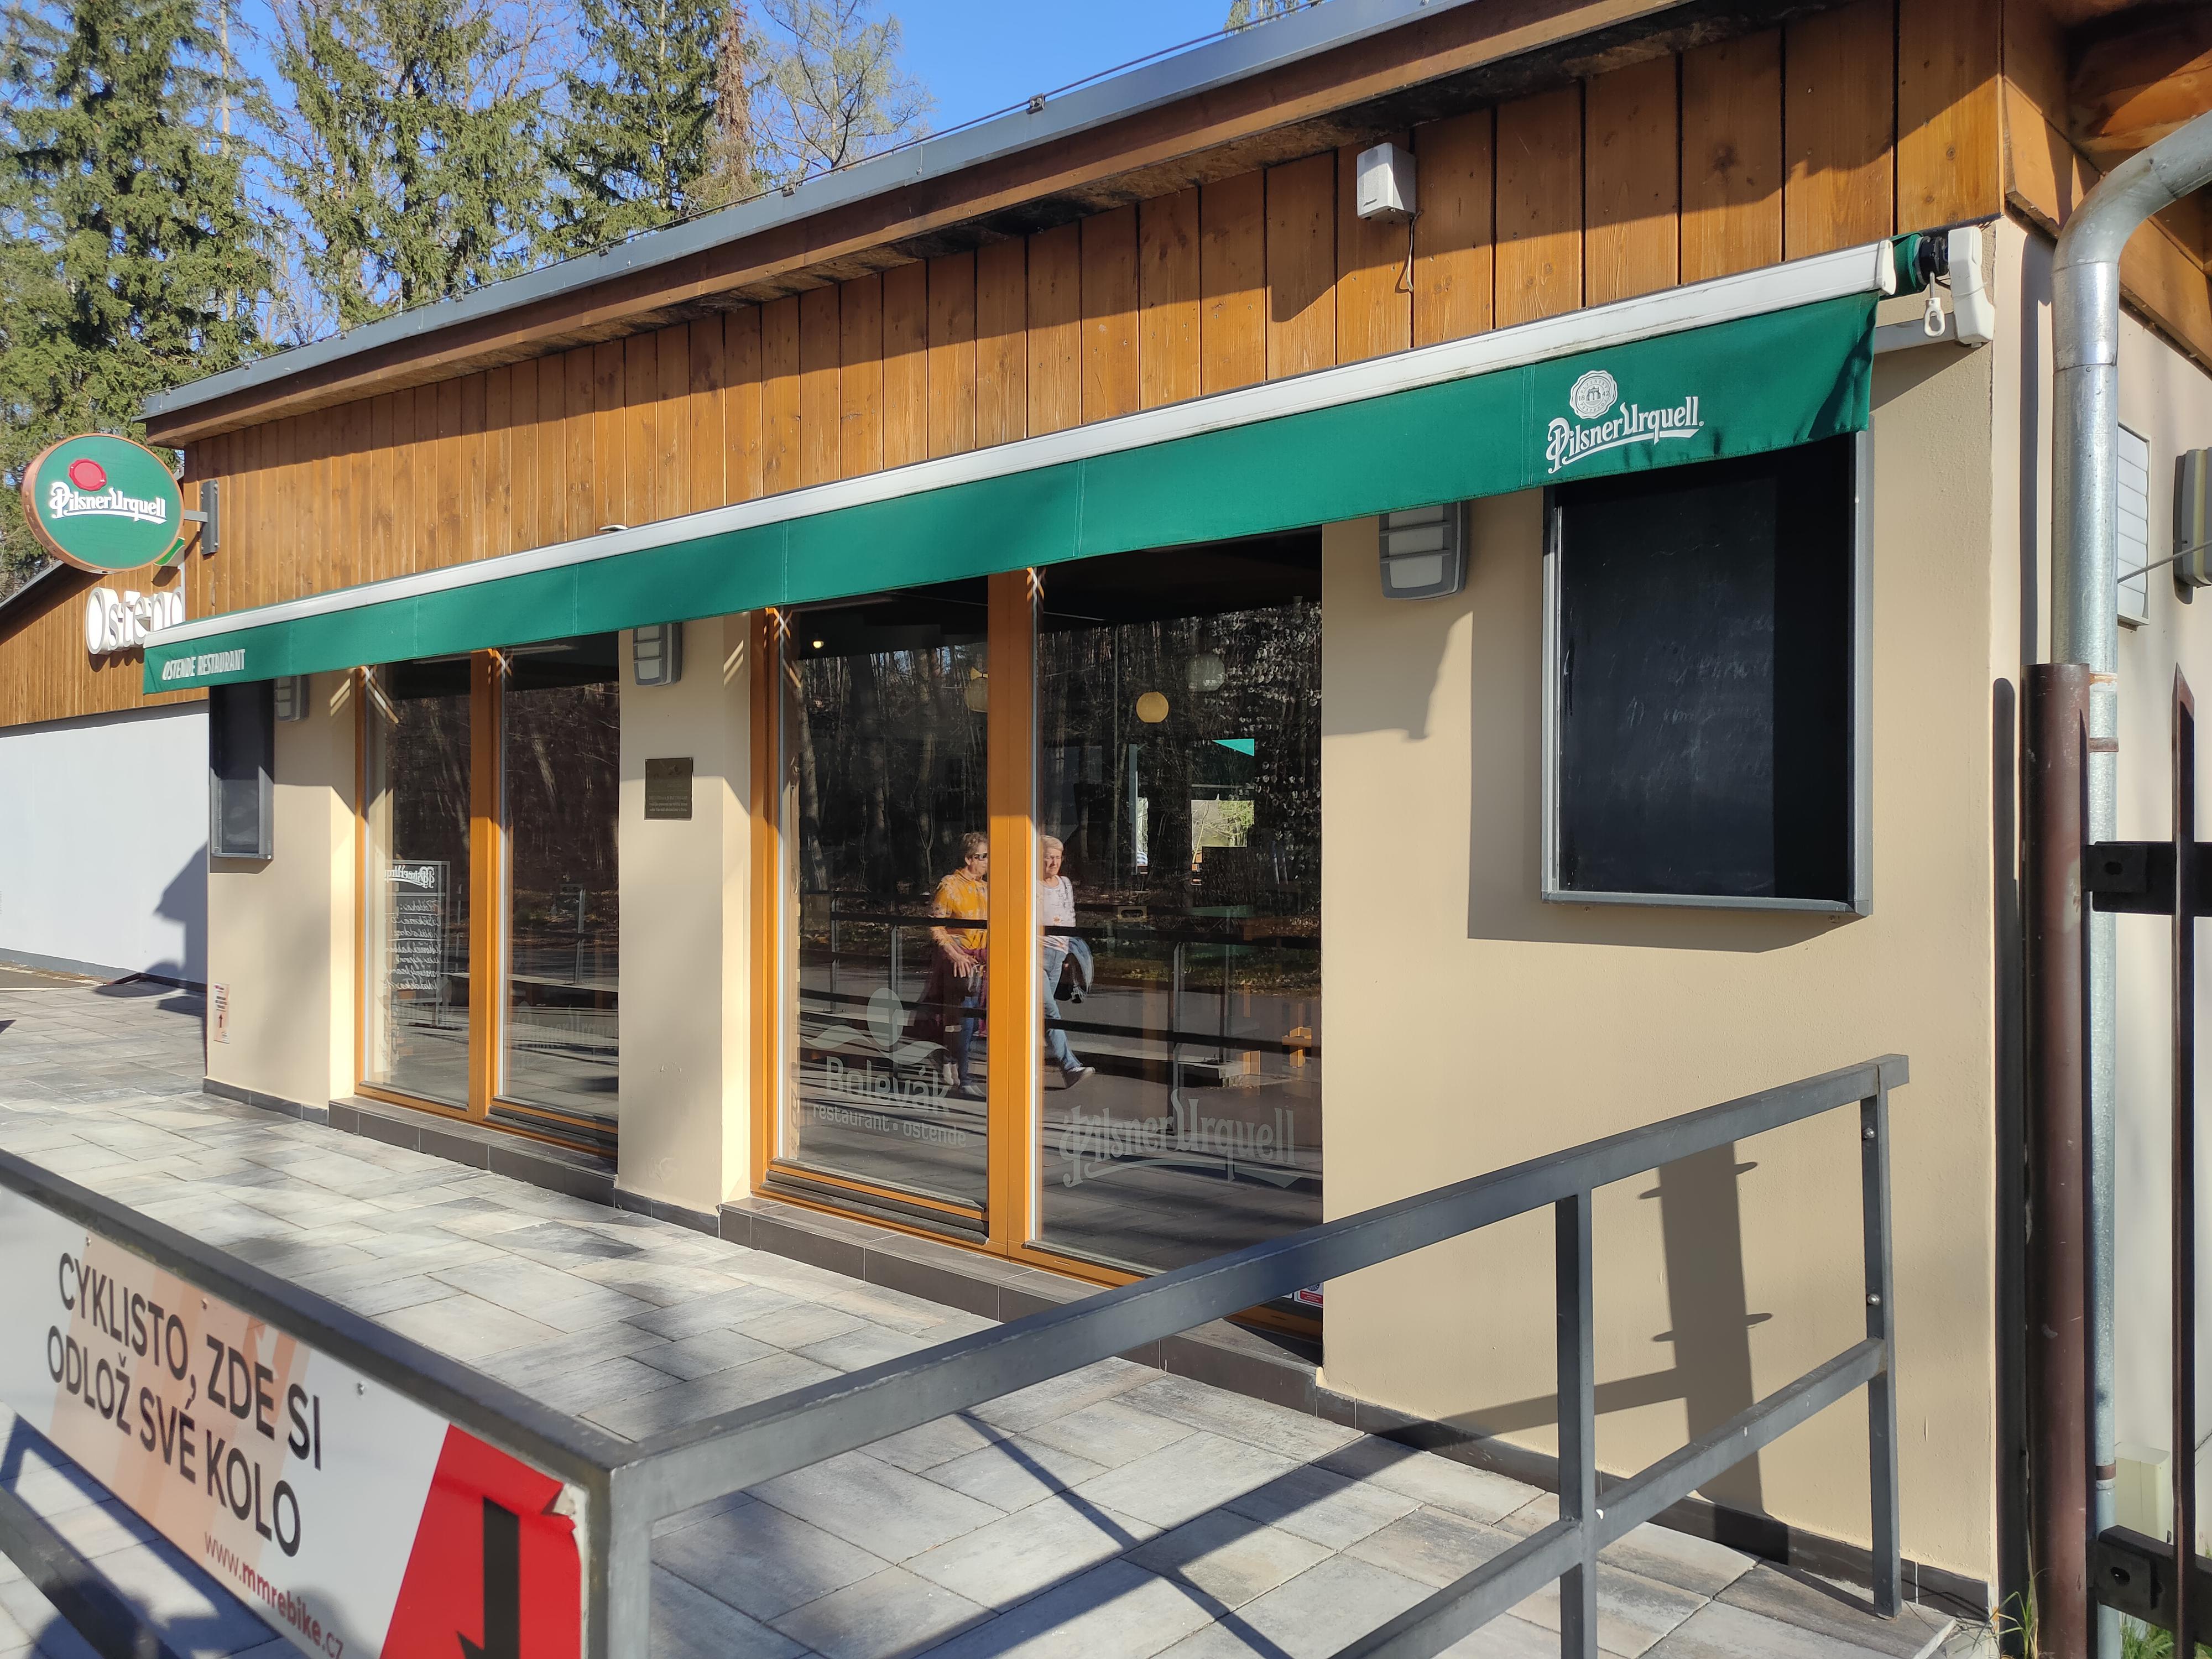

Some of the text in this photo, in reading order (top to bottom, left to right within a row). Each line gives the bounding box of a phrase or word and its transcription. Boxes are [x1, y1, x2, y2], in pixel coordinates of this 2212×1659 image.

[1546, 397, 1698, 474] Pilsner Urquell
[49, 481, 113, 519] Pilsner
[108, 487, 166, 522] Urquell
[162, 649, 246, 680] OSTENDE RESTAURANT
[826, 1056, 950, 1117] Bolevák
[812, 1104, 967, 1148] restaurant ostende
[1059, 1088, 1296, 1188] Pilsner Urquell
[59, 1253, 321, 1472] CYKLISTO, ZDE SI
[47, 1325, 301, 1557] ODLOŽ SVÉ KOLO
[204, 1531, 344, 1659] www.mmrebike.cz
